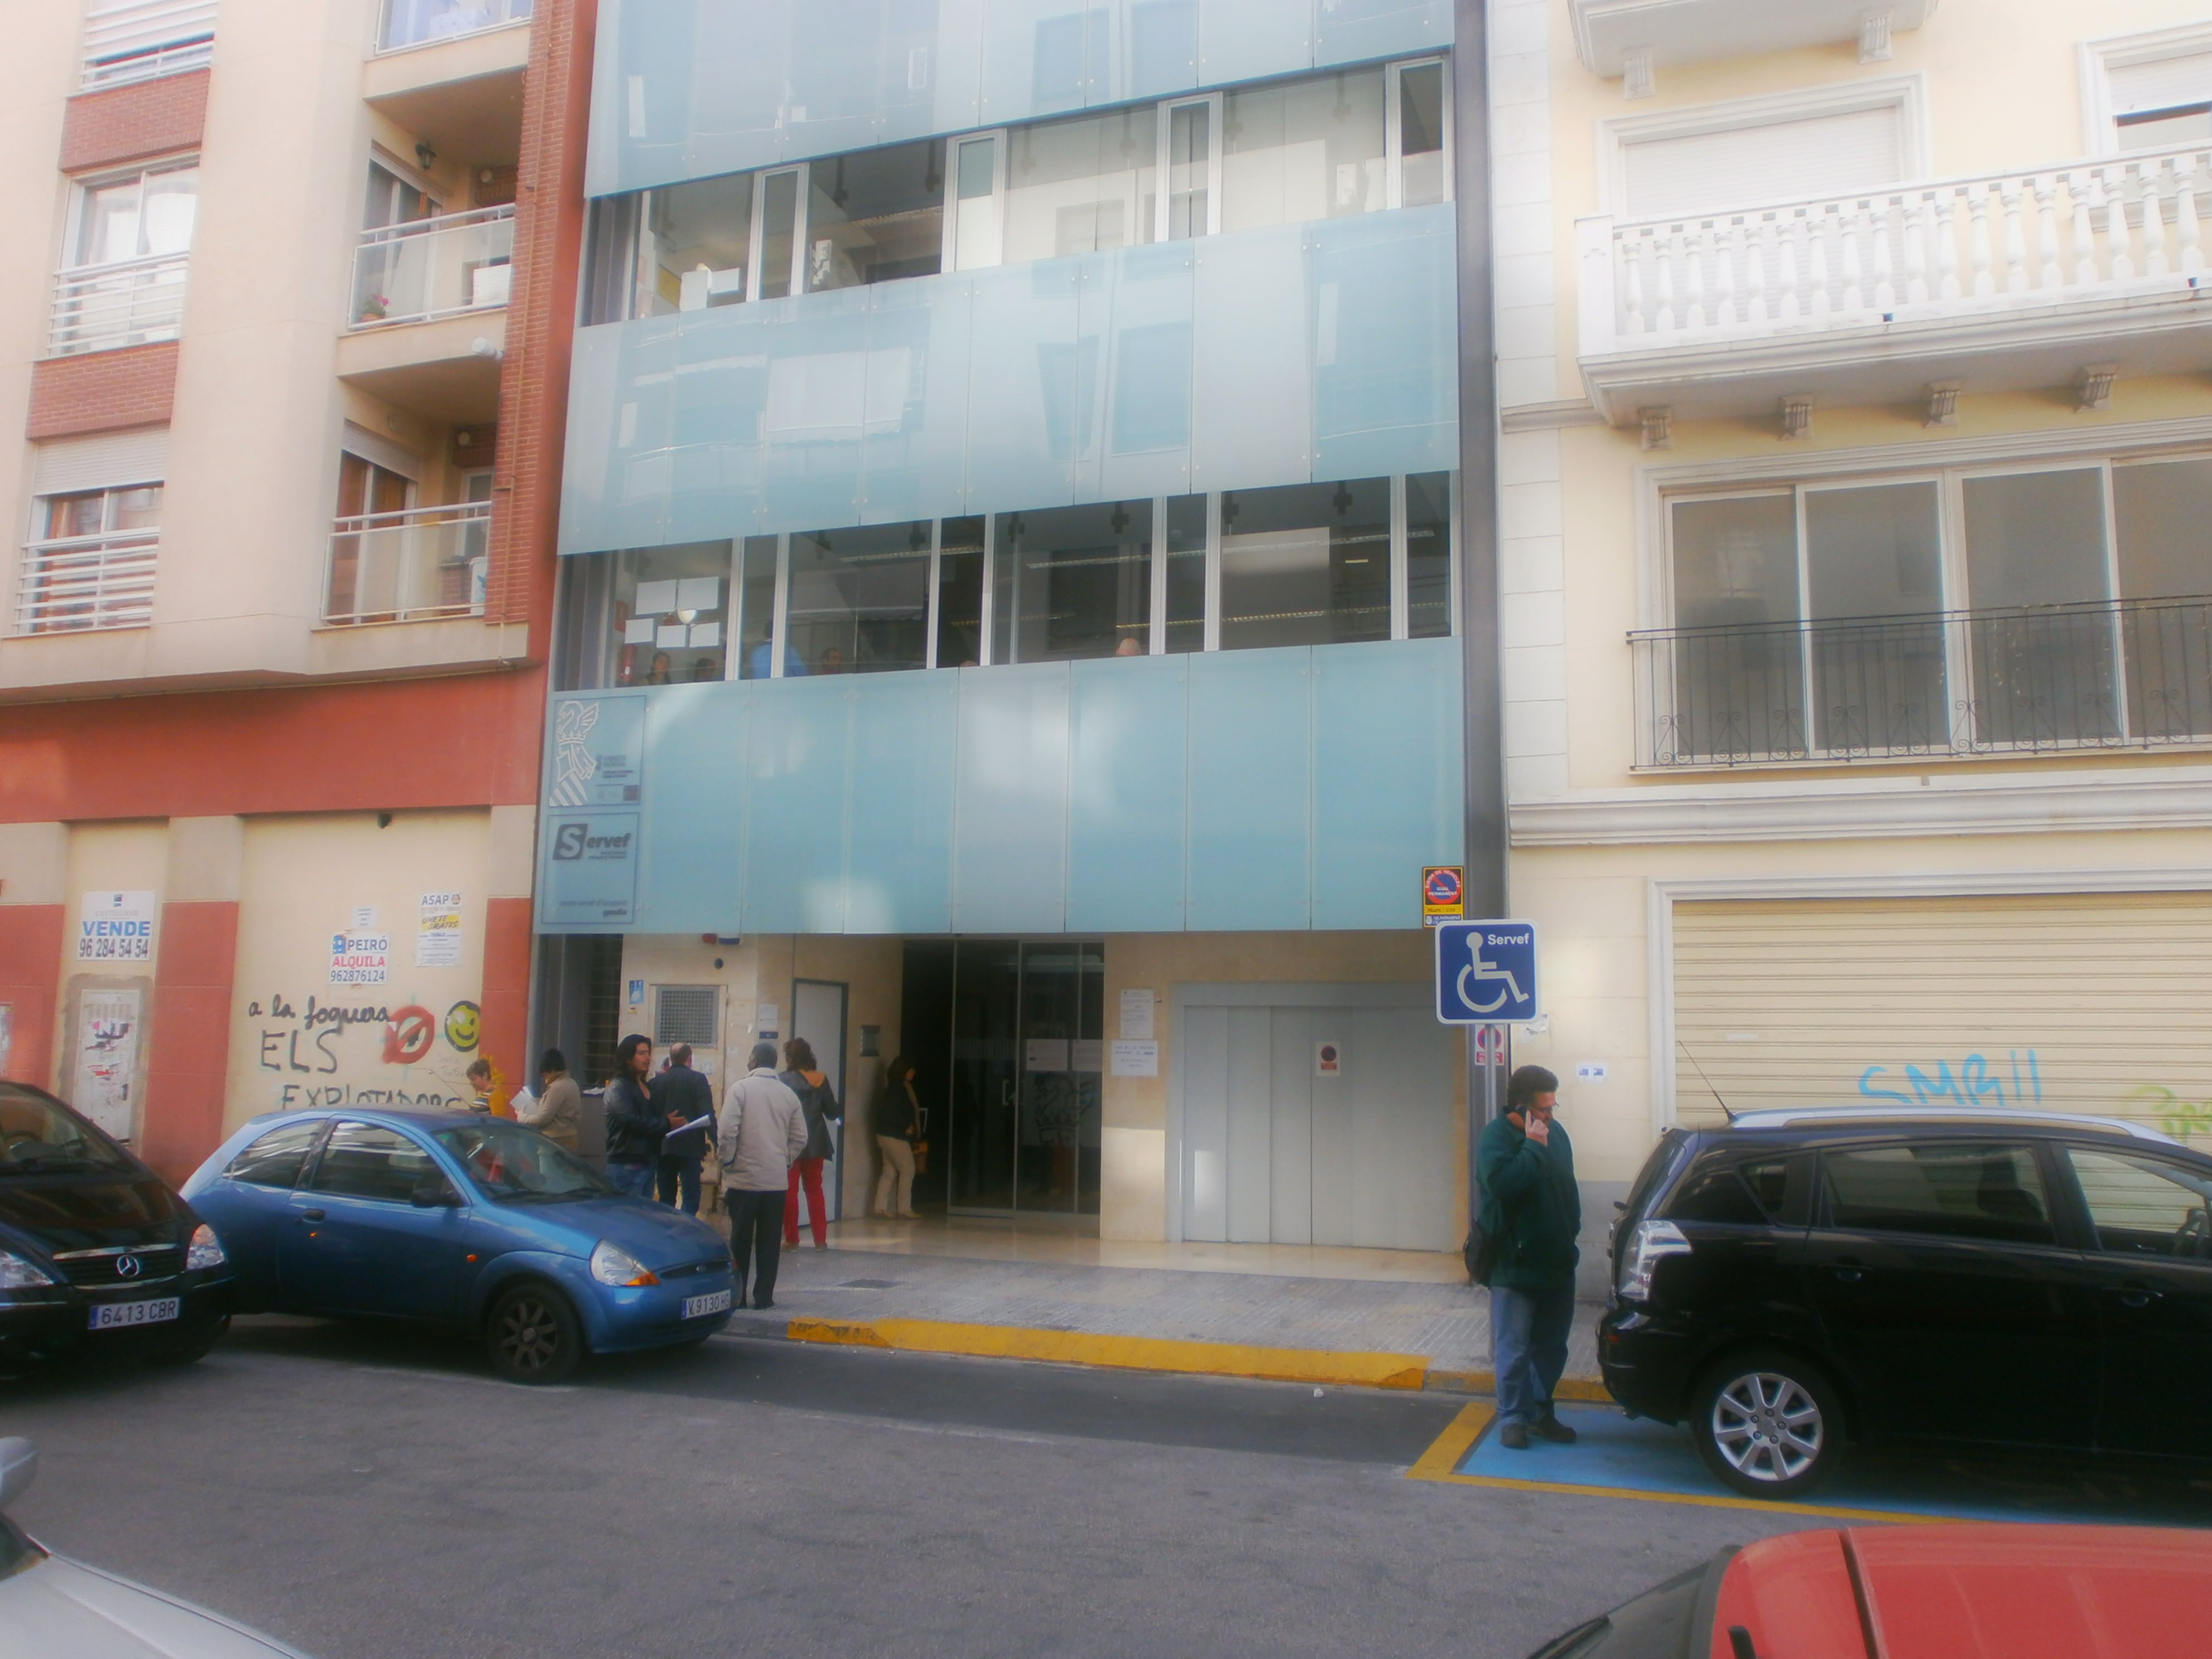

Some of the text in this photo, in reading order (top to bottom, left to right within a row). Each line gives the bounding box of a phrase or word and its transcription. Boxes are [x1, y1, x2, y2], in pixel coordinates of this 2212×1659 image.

[557, 826, 631, 858] Servef
[421, 894, 449, 905] ASAP
[81, 920, 151, 937] VENDE
[347, 935, 387, 951] PEIRÓ
[1487, 933, 1530, 945] Servef
[79, 938, 148, 958] 96 284 54 54
[332, 955, 385, 969] ALQUILA
[330, 970, 385, 982] 962876124
[249, 1001, 263, 1016] a
[261, 1028, 341, 1074] ELS
[101, 1301, 177, 1325] 6413 CBR
